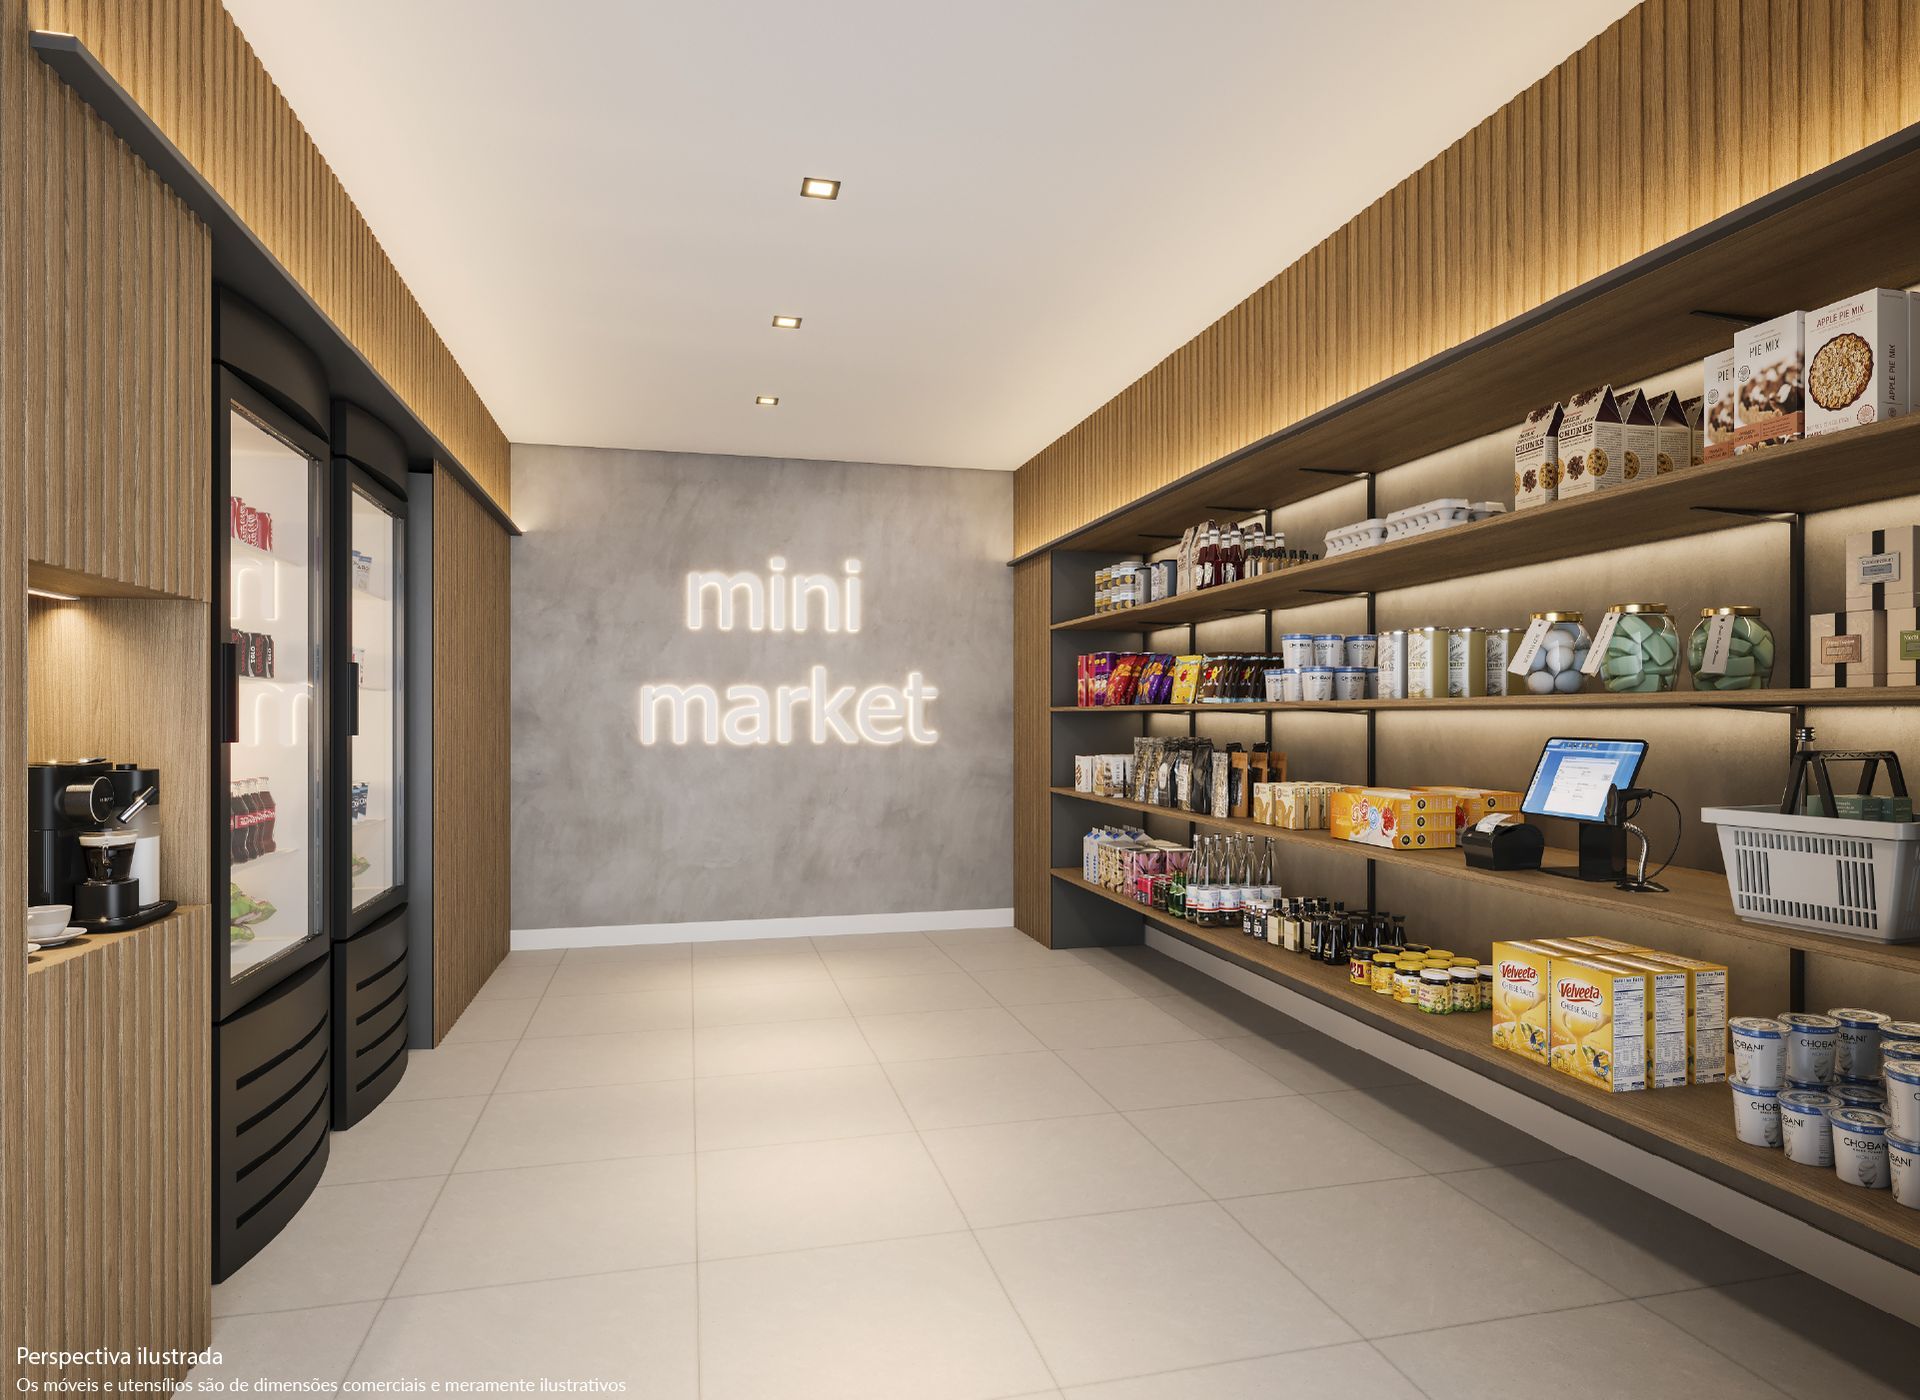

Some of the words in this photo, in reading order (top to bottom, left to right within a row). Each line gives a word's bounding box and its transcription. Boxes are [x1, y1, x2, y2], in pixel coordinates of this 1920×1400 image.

[1816, 313, 1837, 328] APPLE
[1839, 309, 1850, 318] PIE
[1851, 304, 1865, 316] MIX
[1749, 344, 1761, 358] PIE
[1765, 339, 1780, 352] MIX
[1888, 344, 1896, 359] MIX
[1888, 361, 1896, 373] PIE
[1717, 369, 1729, 381] PIE
[1888, 375, 1896, 401] APPLE
[1558, 423, 1593, 438] CHUNKS
[1515, 437, 1544, 453] CHUNKS
[686, 556, 862, 633] mini
[640, 665, 939, 746] market
[1502, 964, 1537, 979] Velveeta
[1560, 982, 1600, 999] Velveeta
[1750, 1101, 1780, 1112] CHOB
[1843, 1137, 1888, 1151] CHOBAN
